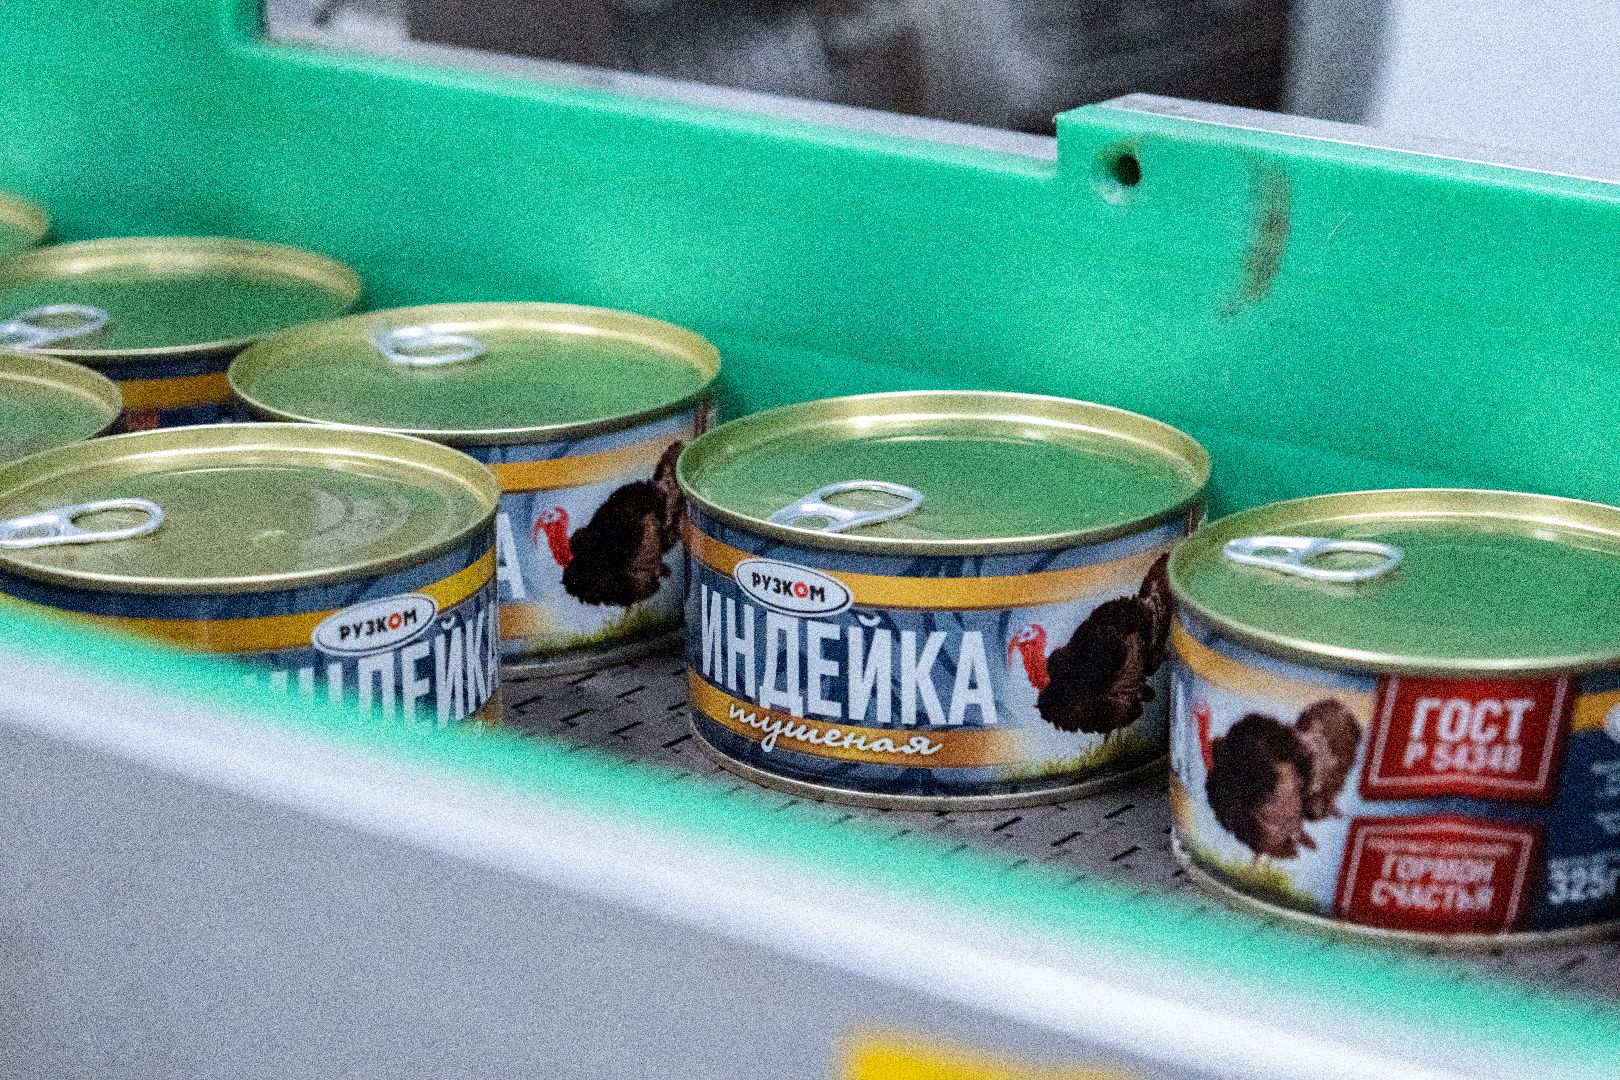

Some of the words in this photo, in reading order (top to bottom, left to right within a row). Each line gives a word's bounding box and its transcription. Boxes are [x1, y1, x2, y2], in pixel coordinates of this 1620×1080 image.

[752, 570, 826, 603] РУЗКОМ
[340, 609, 417, 641] РУЗКОМ
[701, 583, 998, 727] ИНДЕЙКА
[1409, 698, 1535, 743] ГОСТ
[1404, 741, 1427, 768] Р
